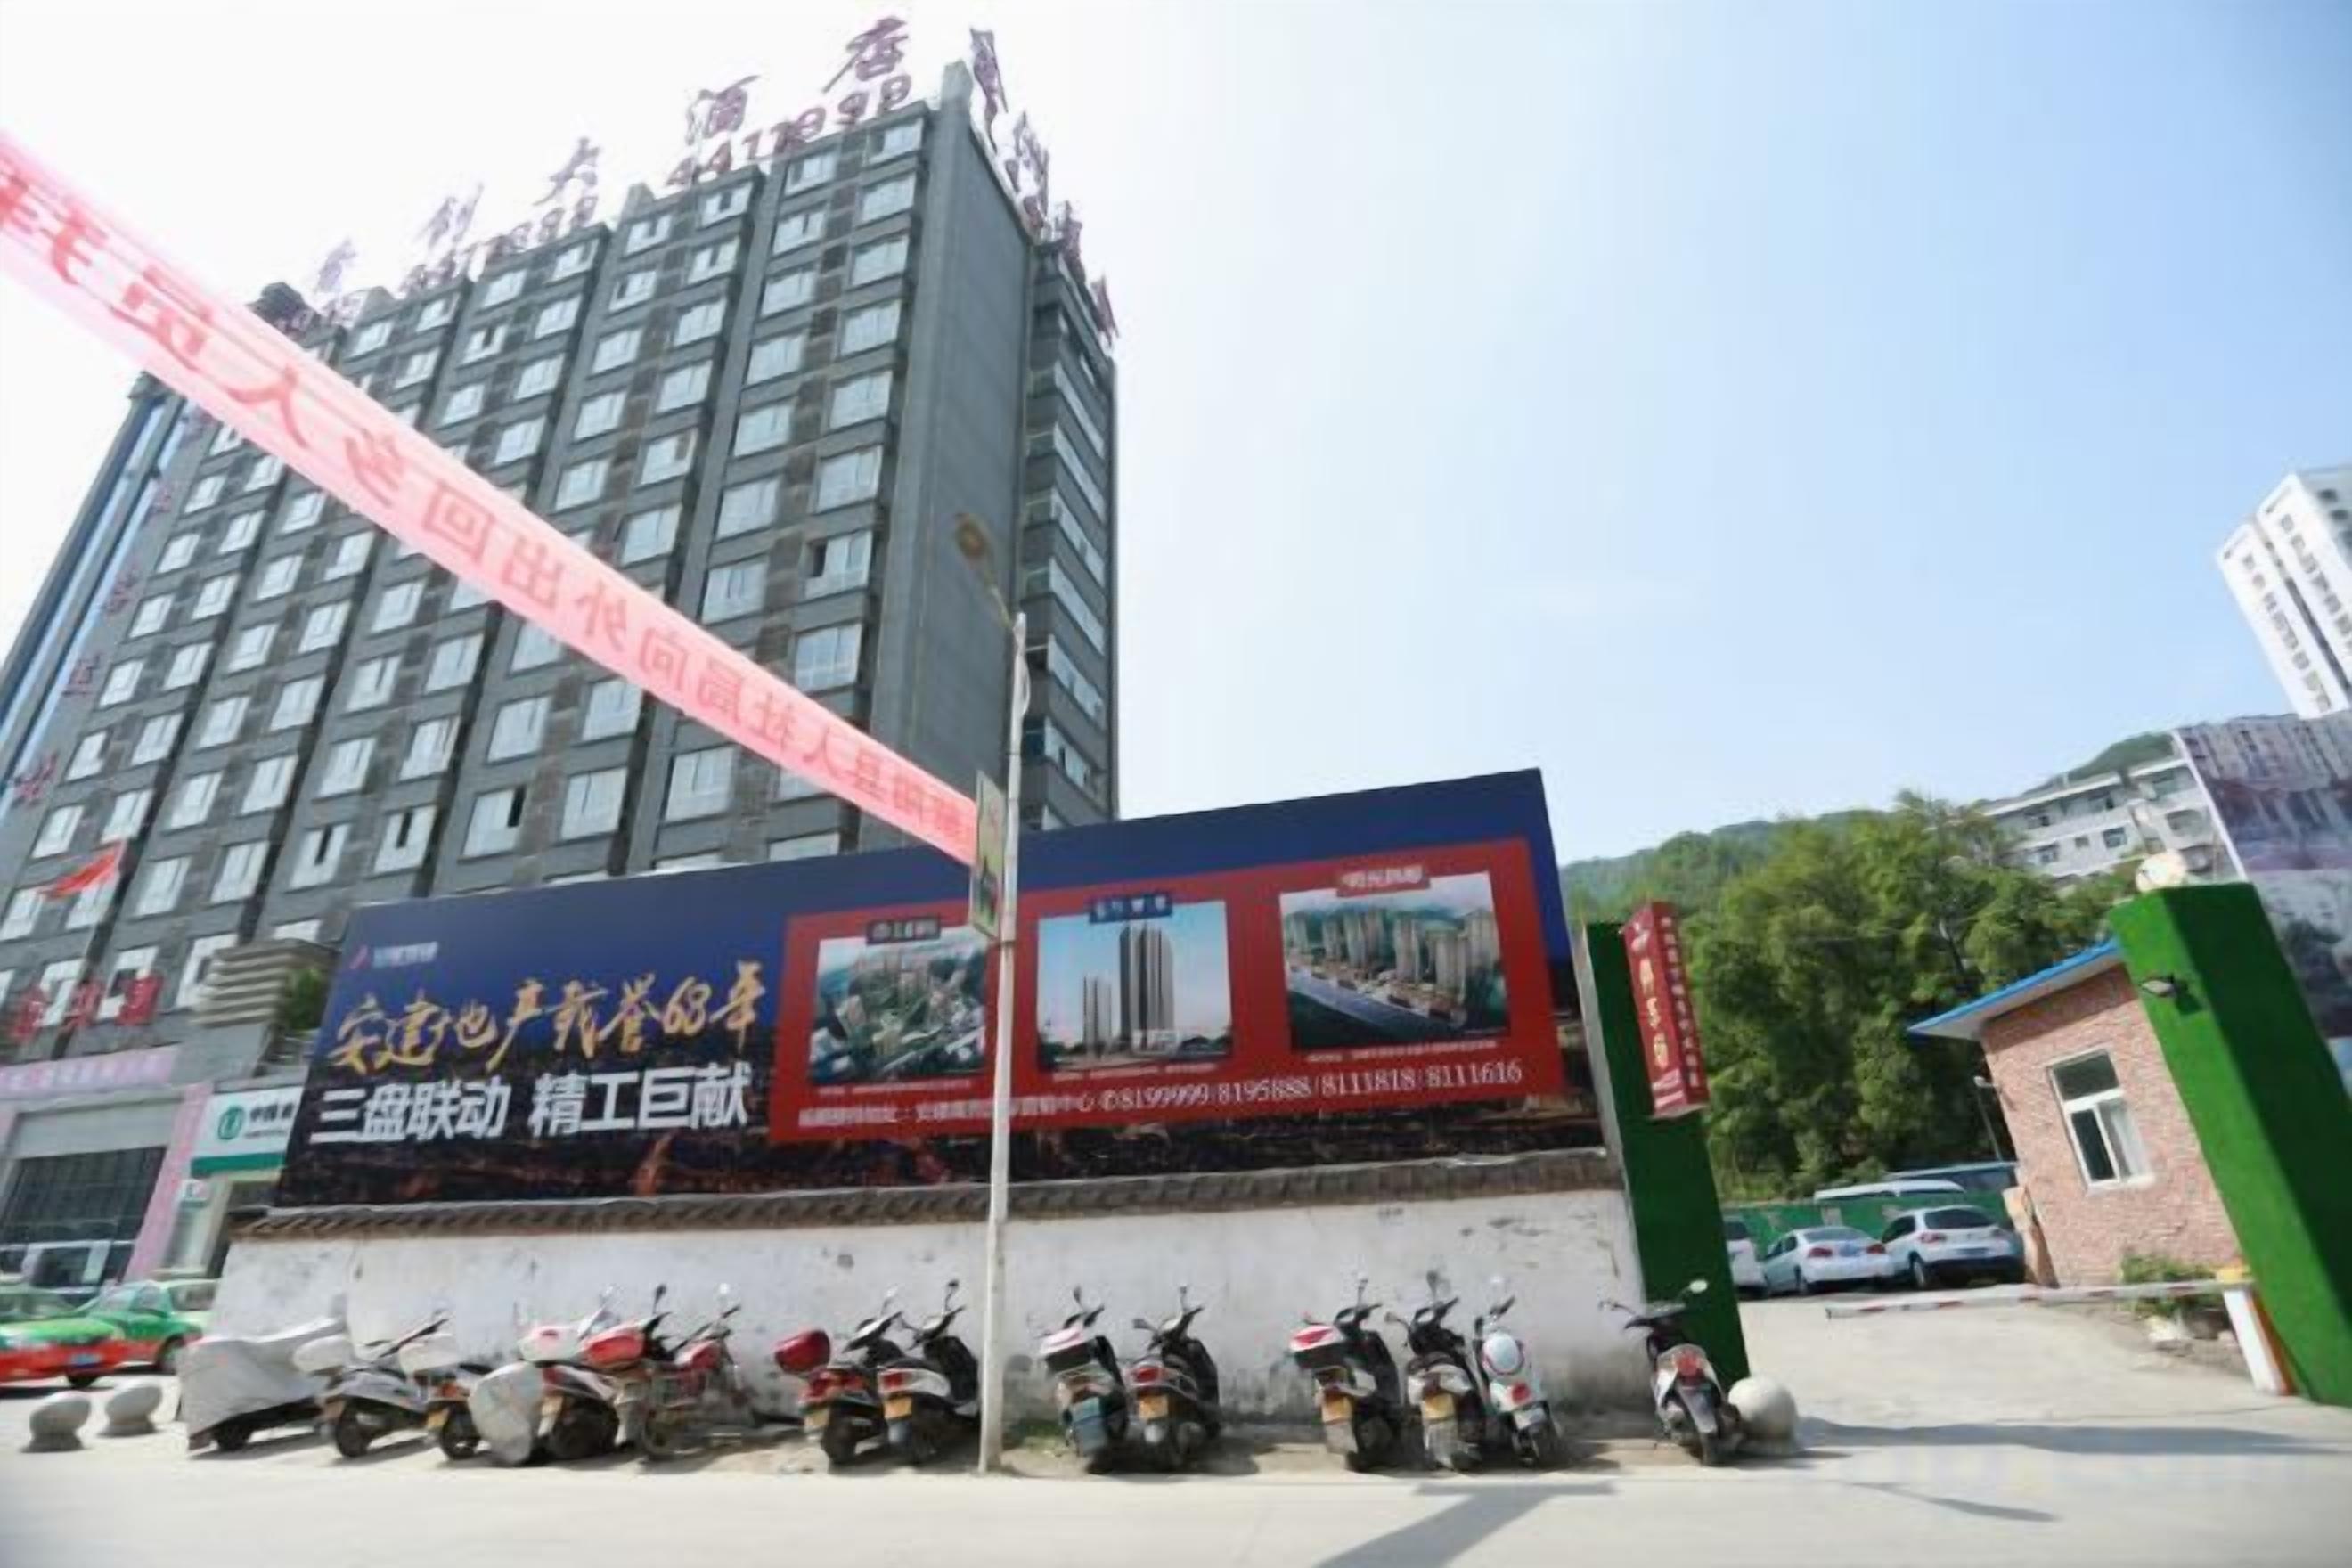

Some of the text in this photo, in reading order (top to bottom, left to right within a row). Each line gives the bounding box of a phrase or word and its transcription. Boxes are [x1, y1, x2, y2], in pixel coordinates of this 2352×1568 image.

[309, 1074, 511, 1144] 三盘联动
[527, 1061, 753, 1138] 精工巨献
